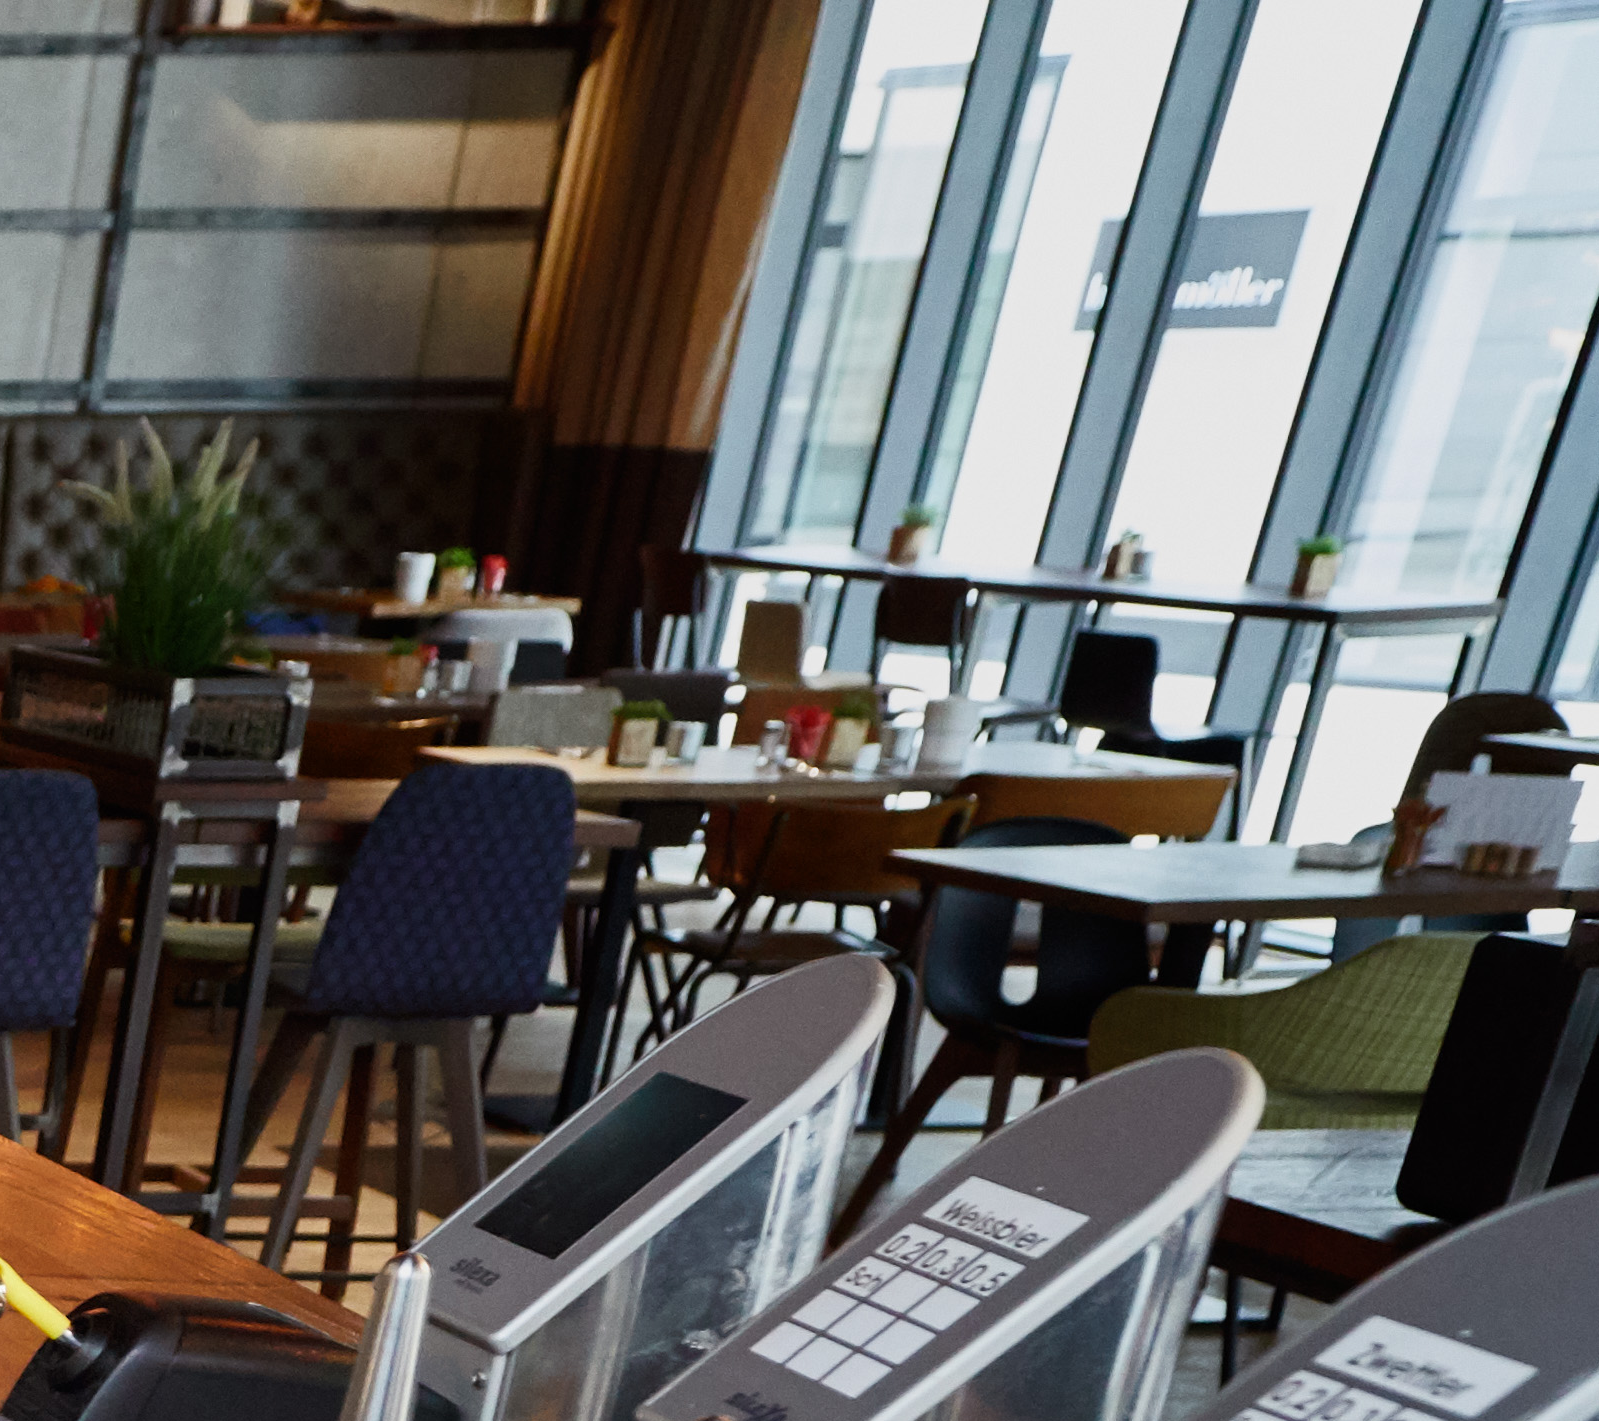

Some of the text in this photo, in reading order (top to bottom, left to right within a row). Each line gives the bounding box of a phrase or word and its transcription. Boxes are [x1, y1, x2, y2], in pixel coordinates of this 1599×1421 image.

[941, 1198, 1050, 1252] Weissbier
[882, 1235, 1008, 1292] 0.2 0.3 0.5
